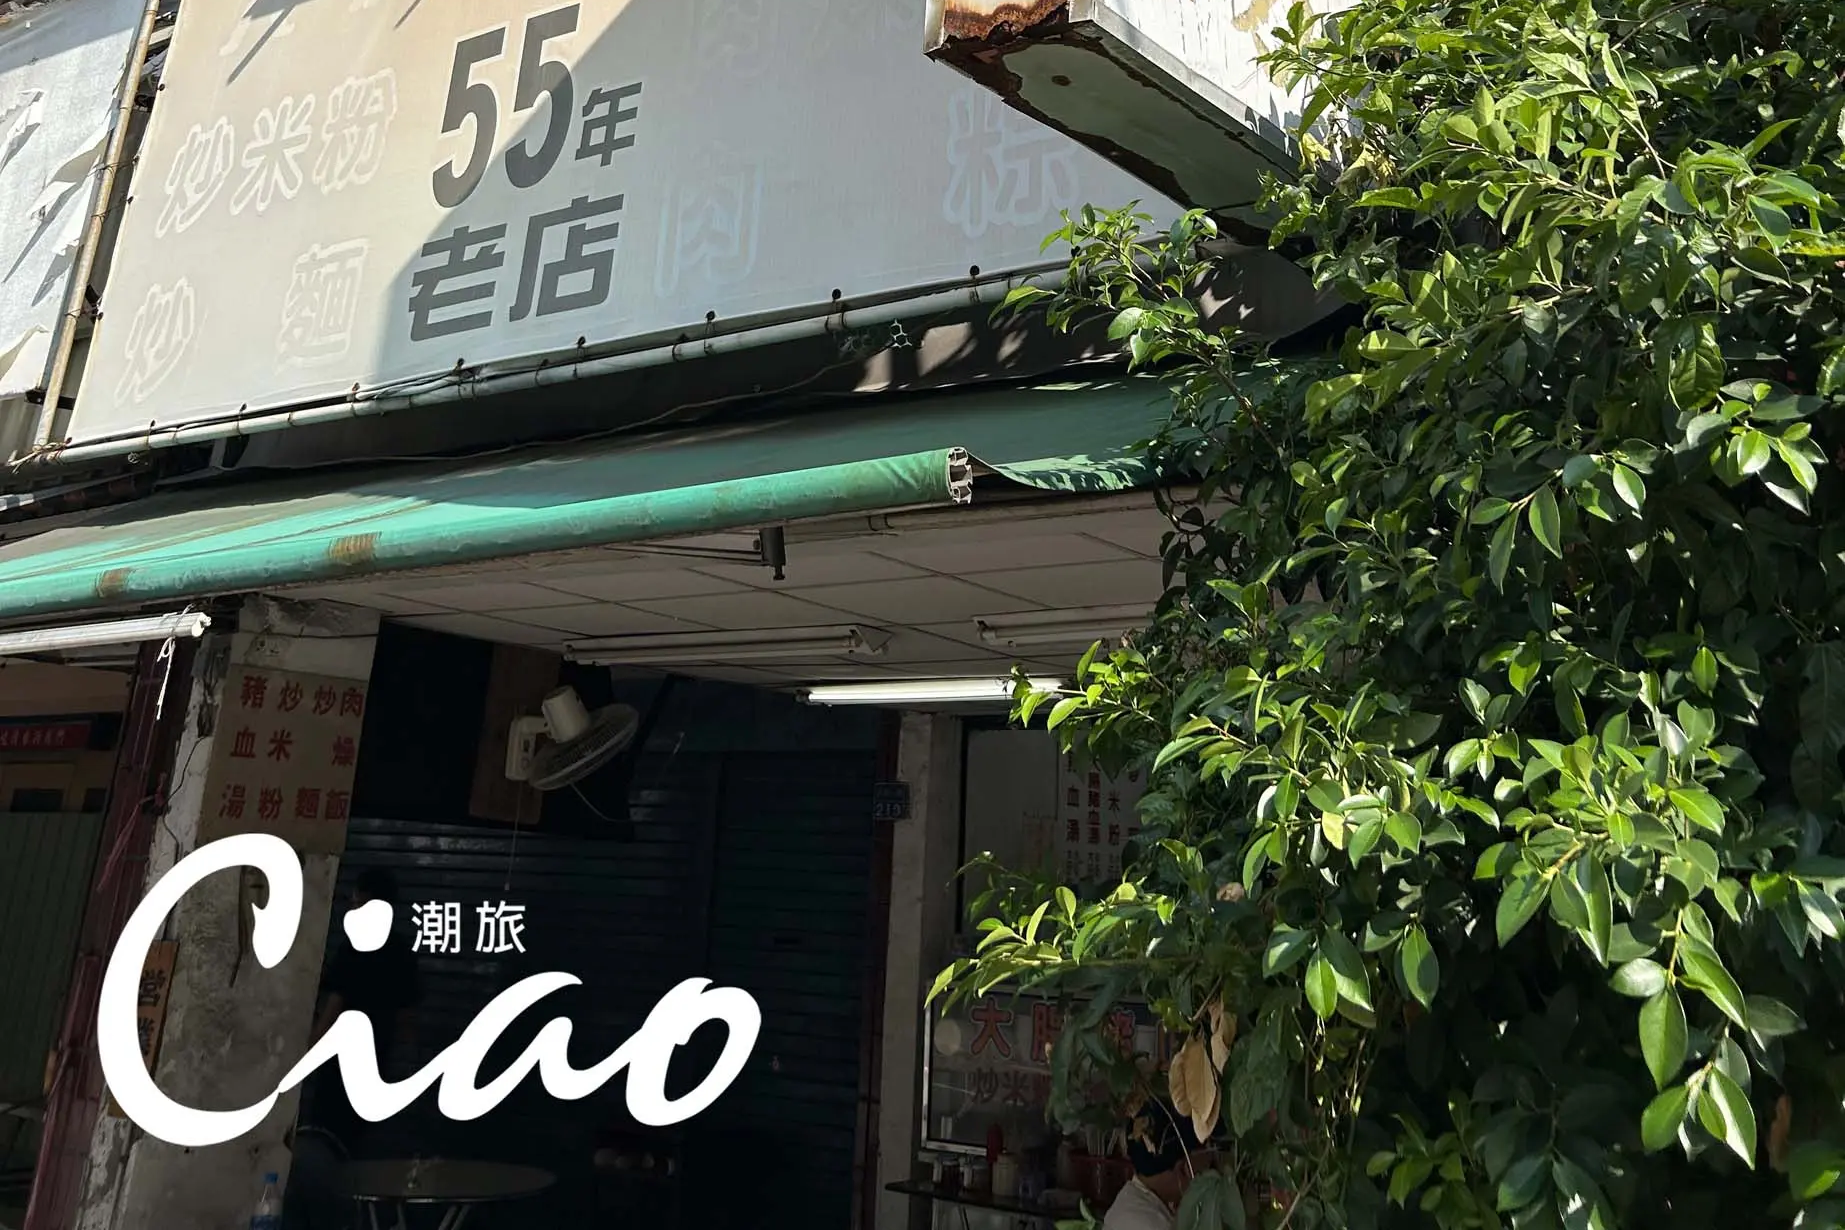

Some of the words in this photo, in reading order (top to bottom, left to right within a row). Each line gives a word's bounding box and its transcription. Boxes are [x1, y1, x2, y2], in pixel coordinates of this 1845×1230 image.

[154, 67, 398, 240] 炒米粉
[432, 2, 643, 208] 55年
[408, 193, 624, 342] 老店
[218, 674, 269, 821] 豬血湯
[257, 678, 305, 822] 炒米粉
